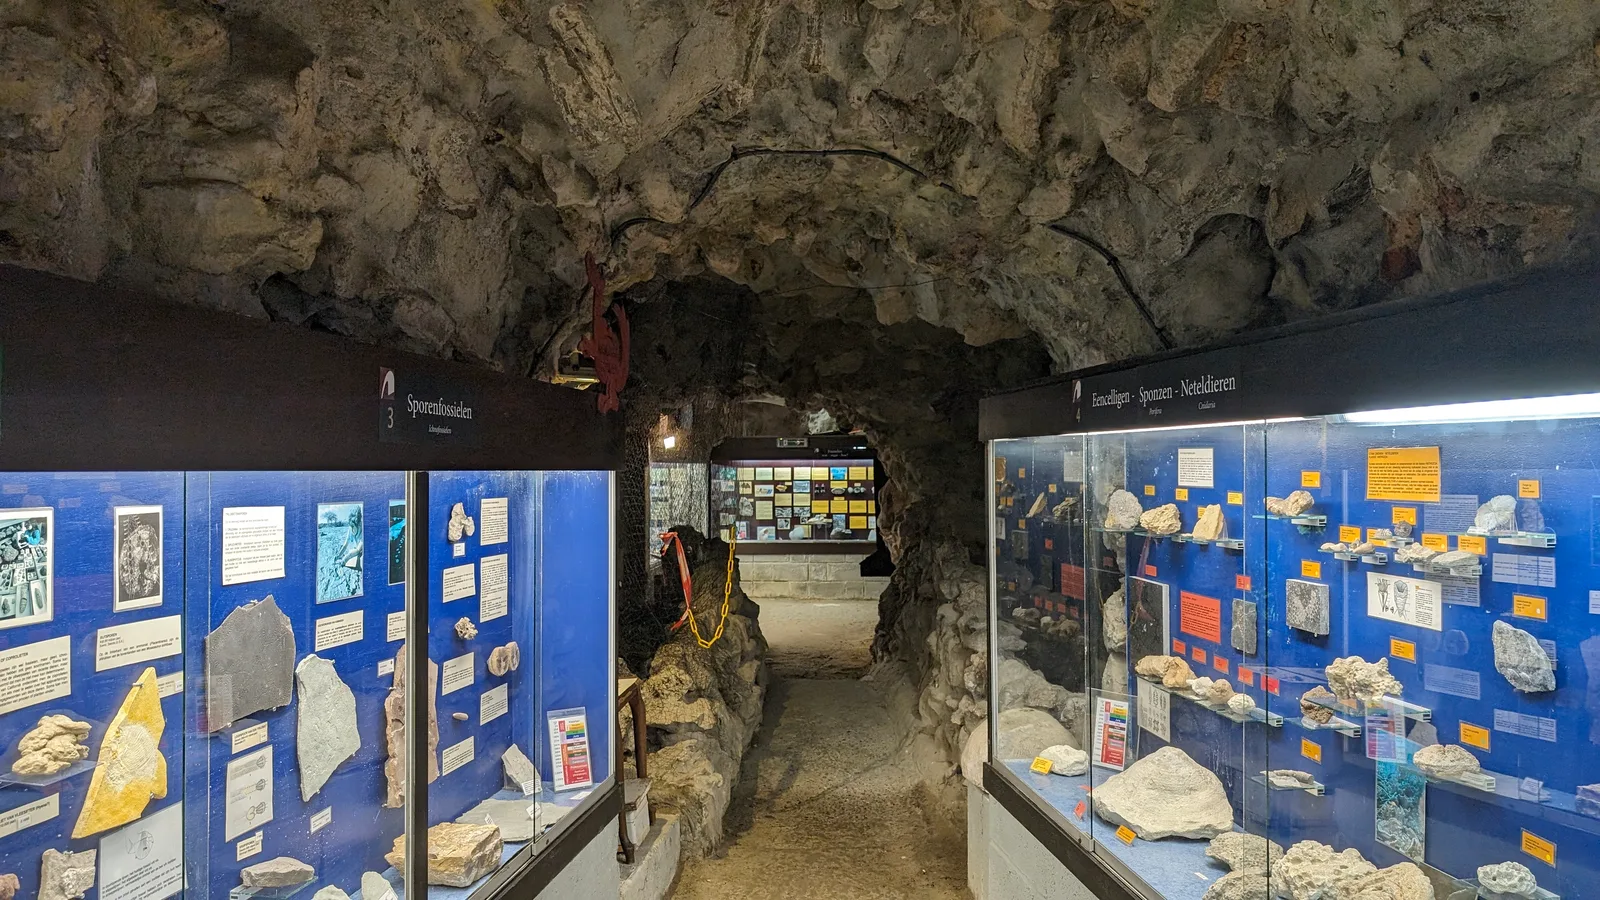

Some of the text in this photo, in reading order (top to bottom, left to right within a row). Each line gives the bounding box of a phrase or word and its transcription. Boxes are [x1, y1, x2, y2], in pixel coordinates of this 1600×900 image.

[1092, 388, 1130, 409] Eencelligen
[1139, 386, 1173, 408] Sponzen
[1180, 374, 1236, 397] Neteldieren
[387, 407, 394, 429] 3
[407, 393, 472, 420] Sporenfossielen
